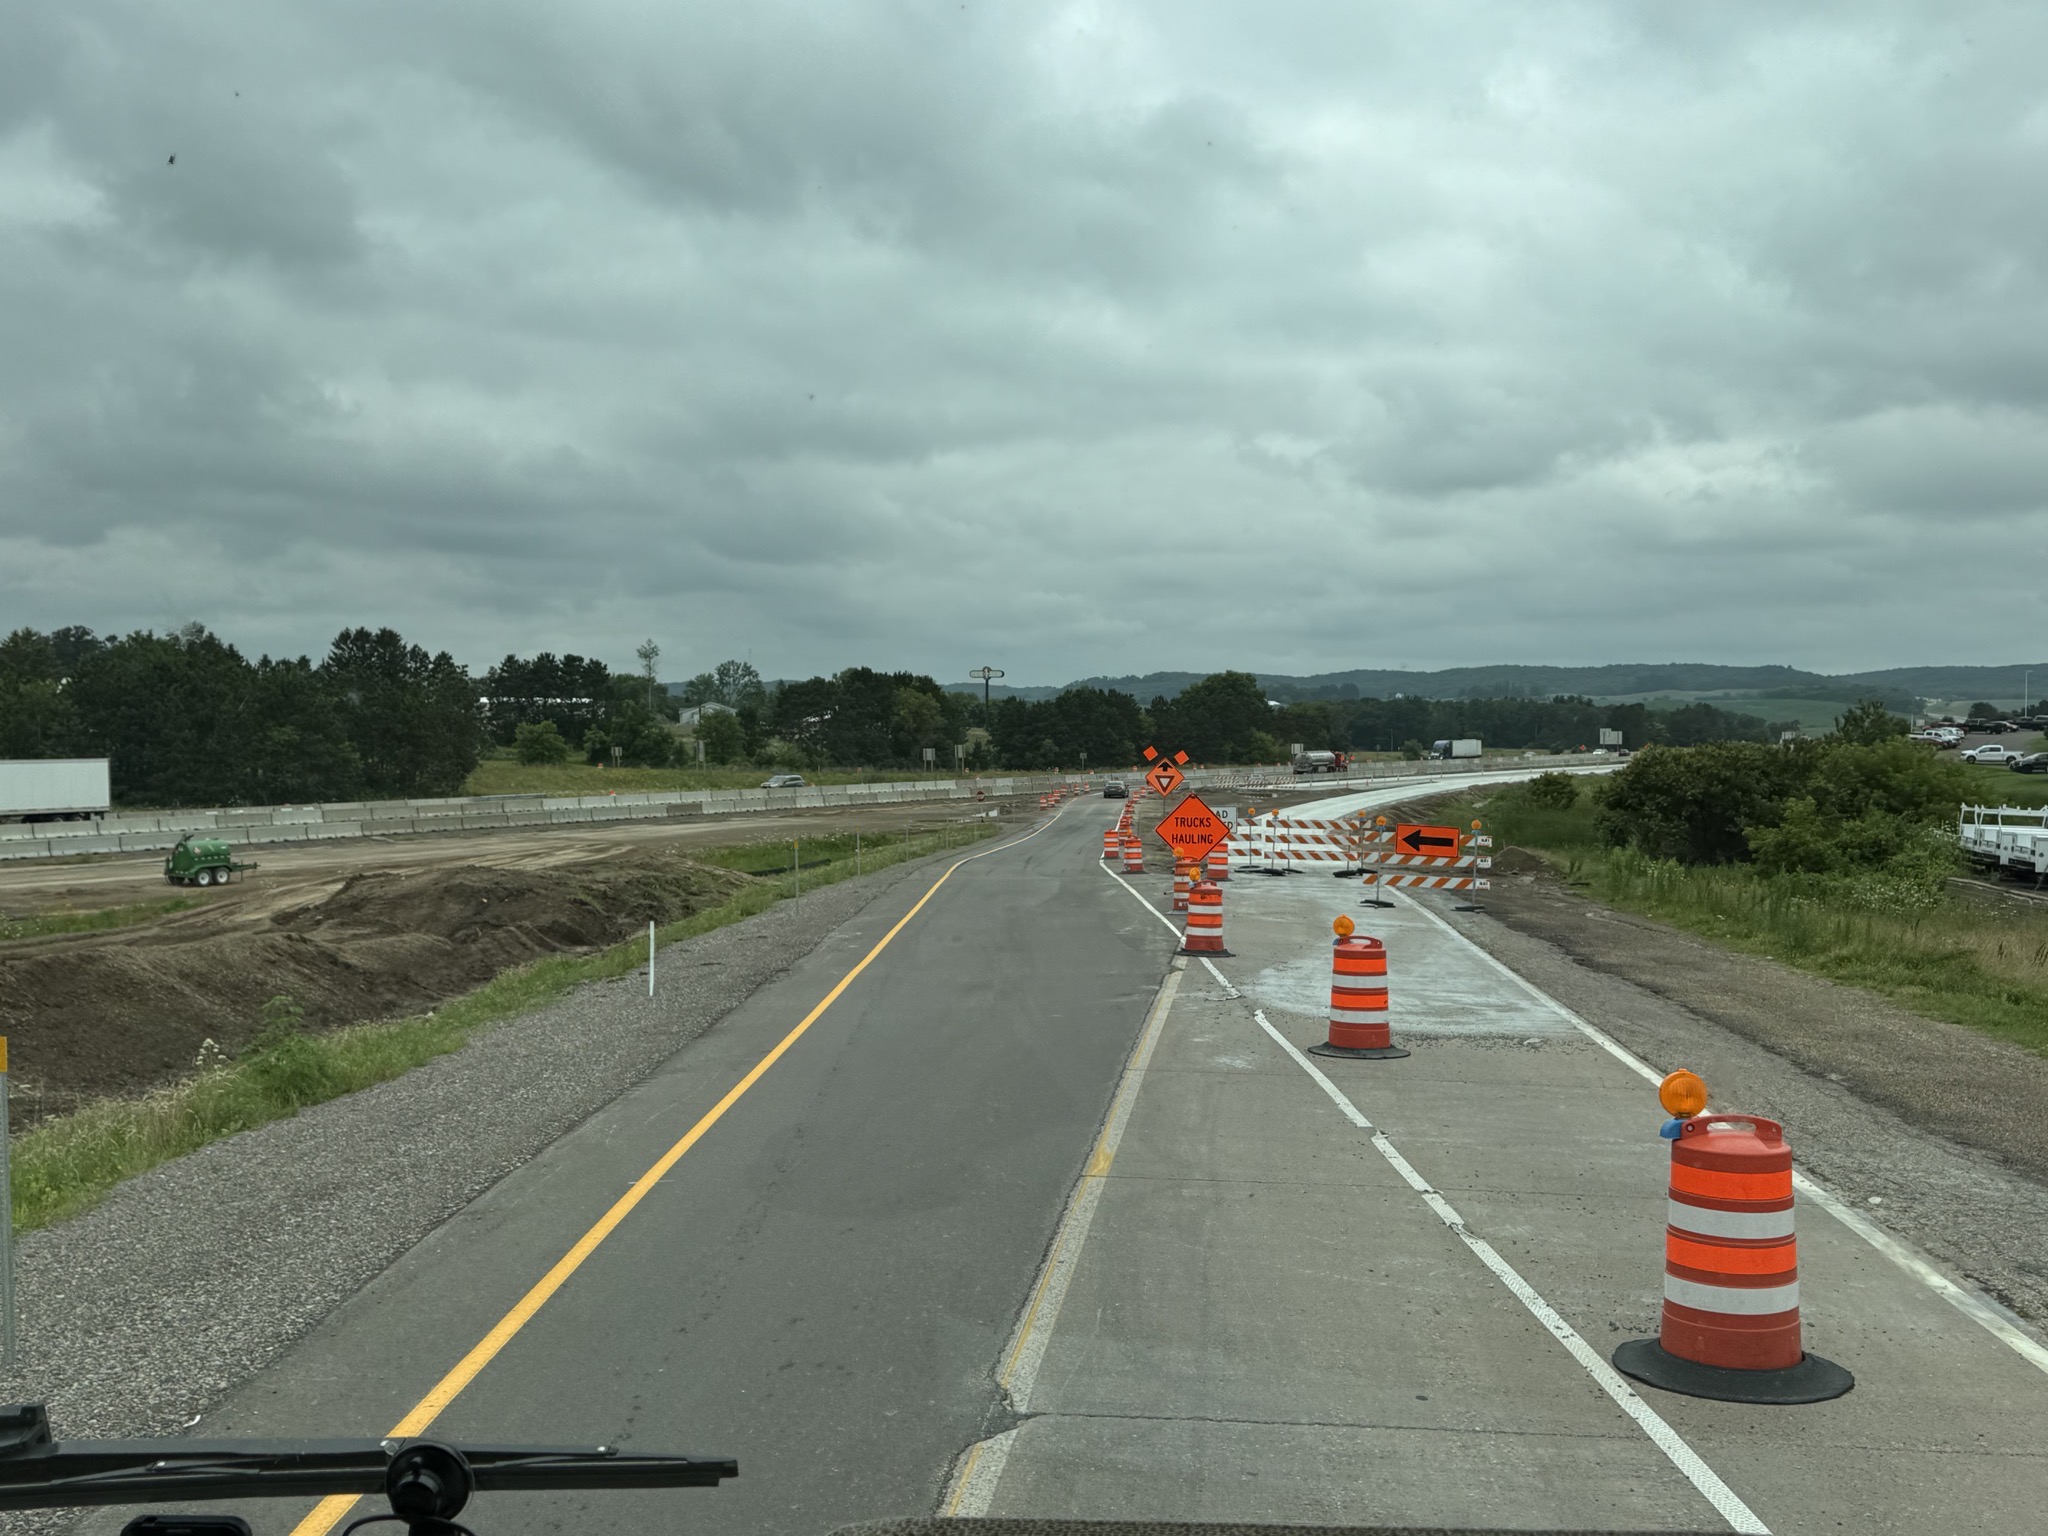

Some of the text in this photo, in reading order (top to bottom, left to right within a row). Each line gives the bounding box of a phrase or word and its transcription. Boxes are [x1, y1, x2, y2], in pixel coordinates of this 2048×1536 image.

[1215, 810, 1228, 819] AD
[1174, 817, 1211, 828] TRUCKS
[1171, 834, 1213, 844] HAULING
